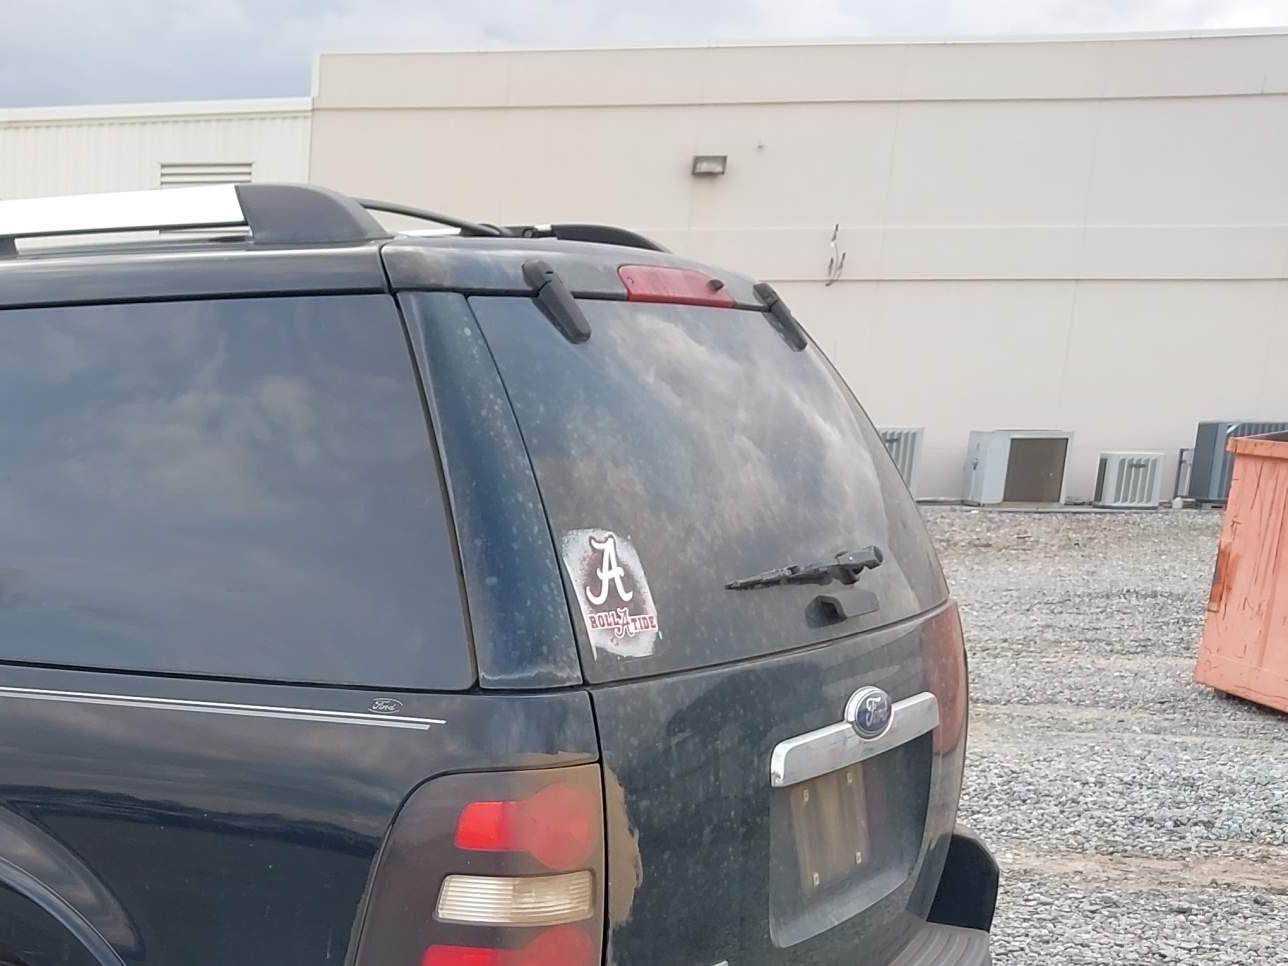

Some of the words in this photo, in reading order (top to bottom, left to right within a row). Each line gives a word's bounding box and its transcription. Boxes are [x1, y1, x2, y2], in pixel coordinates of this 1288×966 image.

[585, 536, 633, 605] A
[589, 612, 618, 629] ROLL
[632, 615, 657, 632] TIDE
